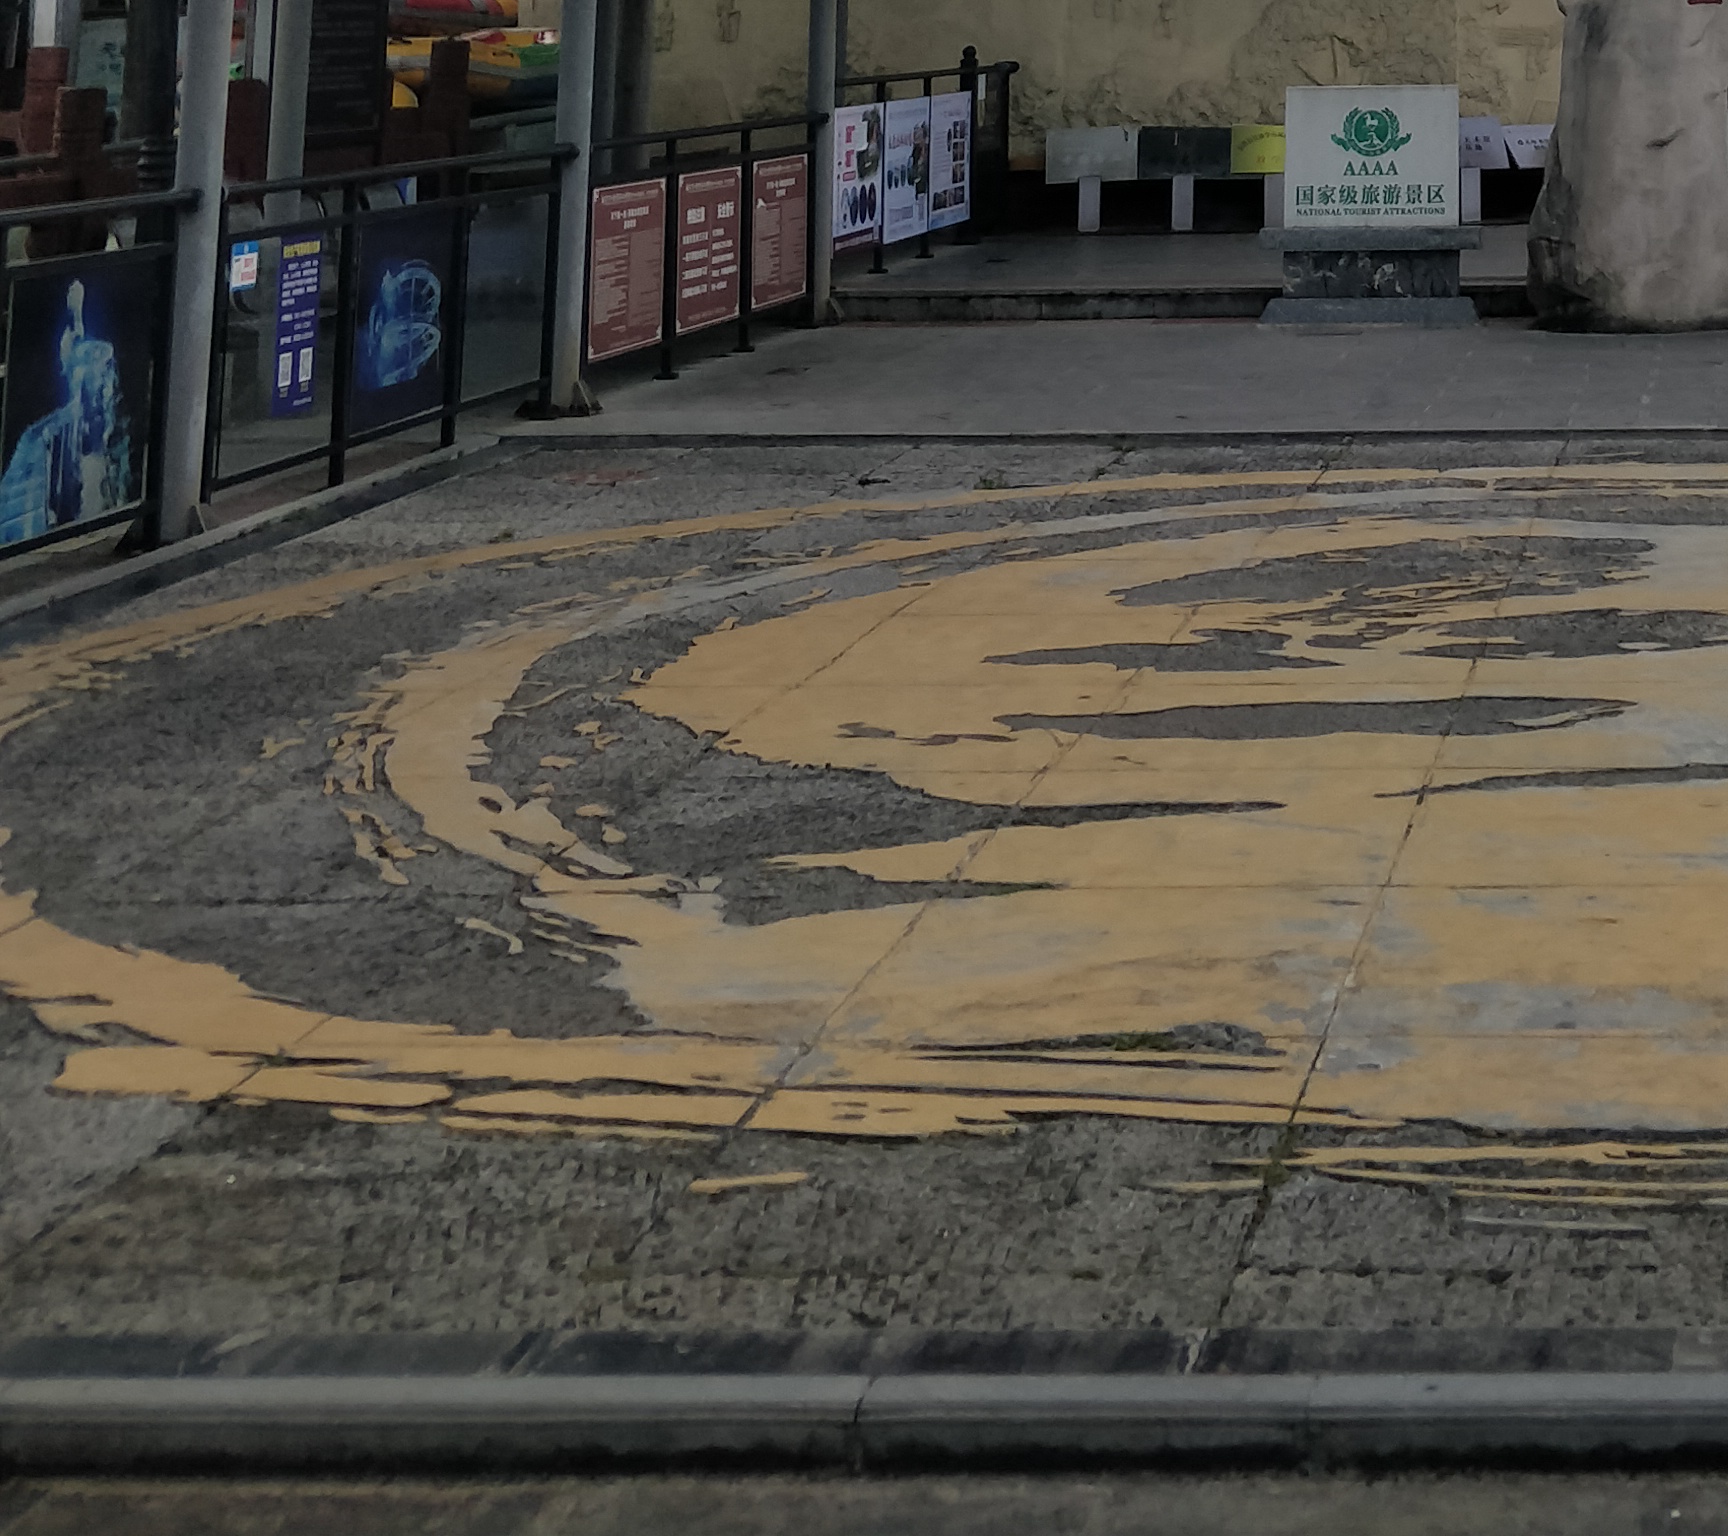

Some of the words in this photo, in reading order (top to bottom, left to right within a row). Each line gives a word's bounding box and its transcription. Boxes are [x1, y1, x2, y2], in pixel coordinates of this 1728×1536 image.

[1343, 160, 1399, 176] AAAA
[1295, 183, 1446, 206] 国家级旅游景区
[1296, 207, 1341, 217] NATIONAL
[1344, 207, 1381, 216] TOURIST
[1383, 206, 1446, 216] ATTRACTIONS
